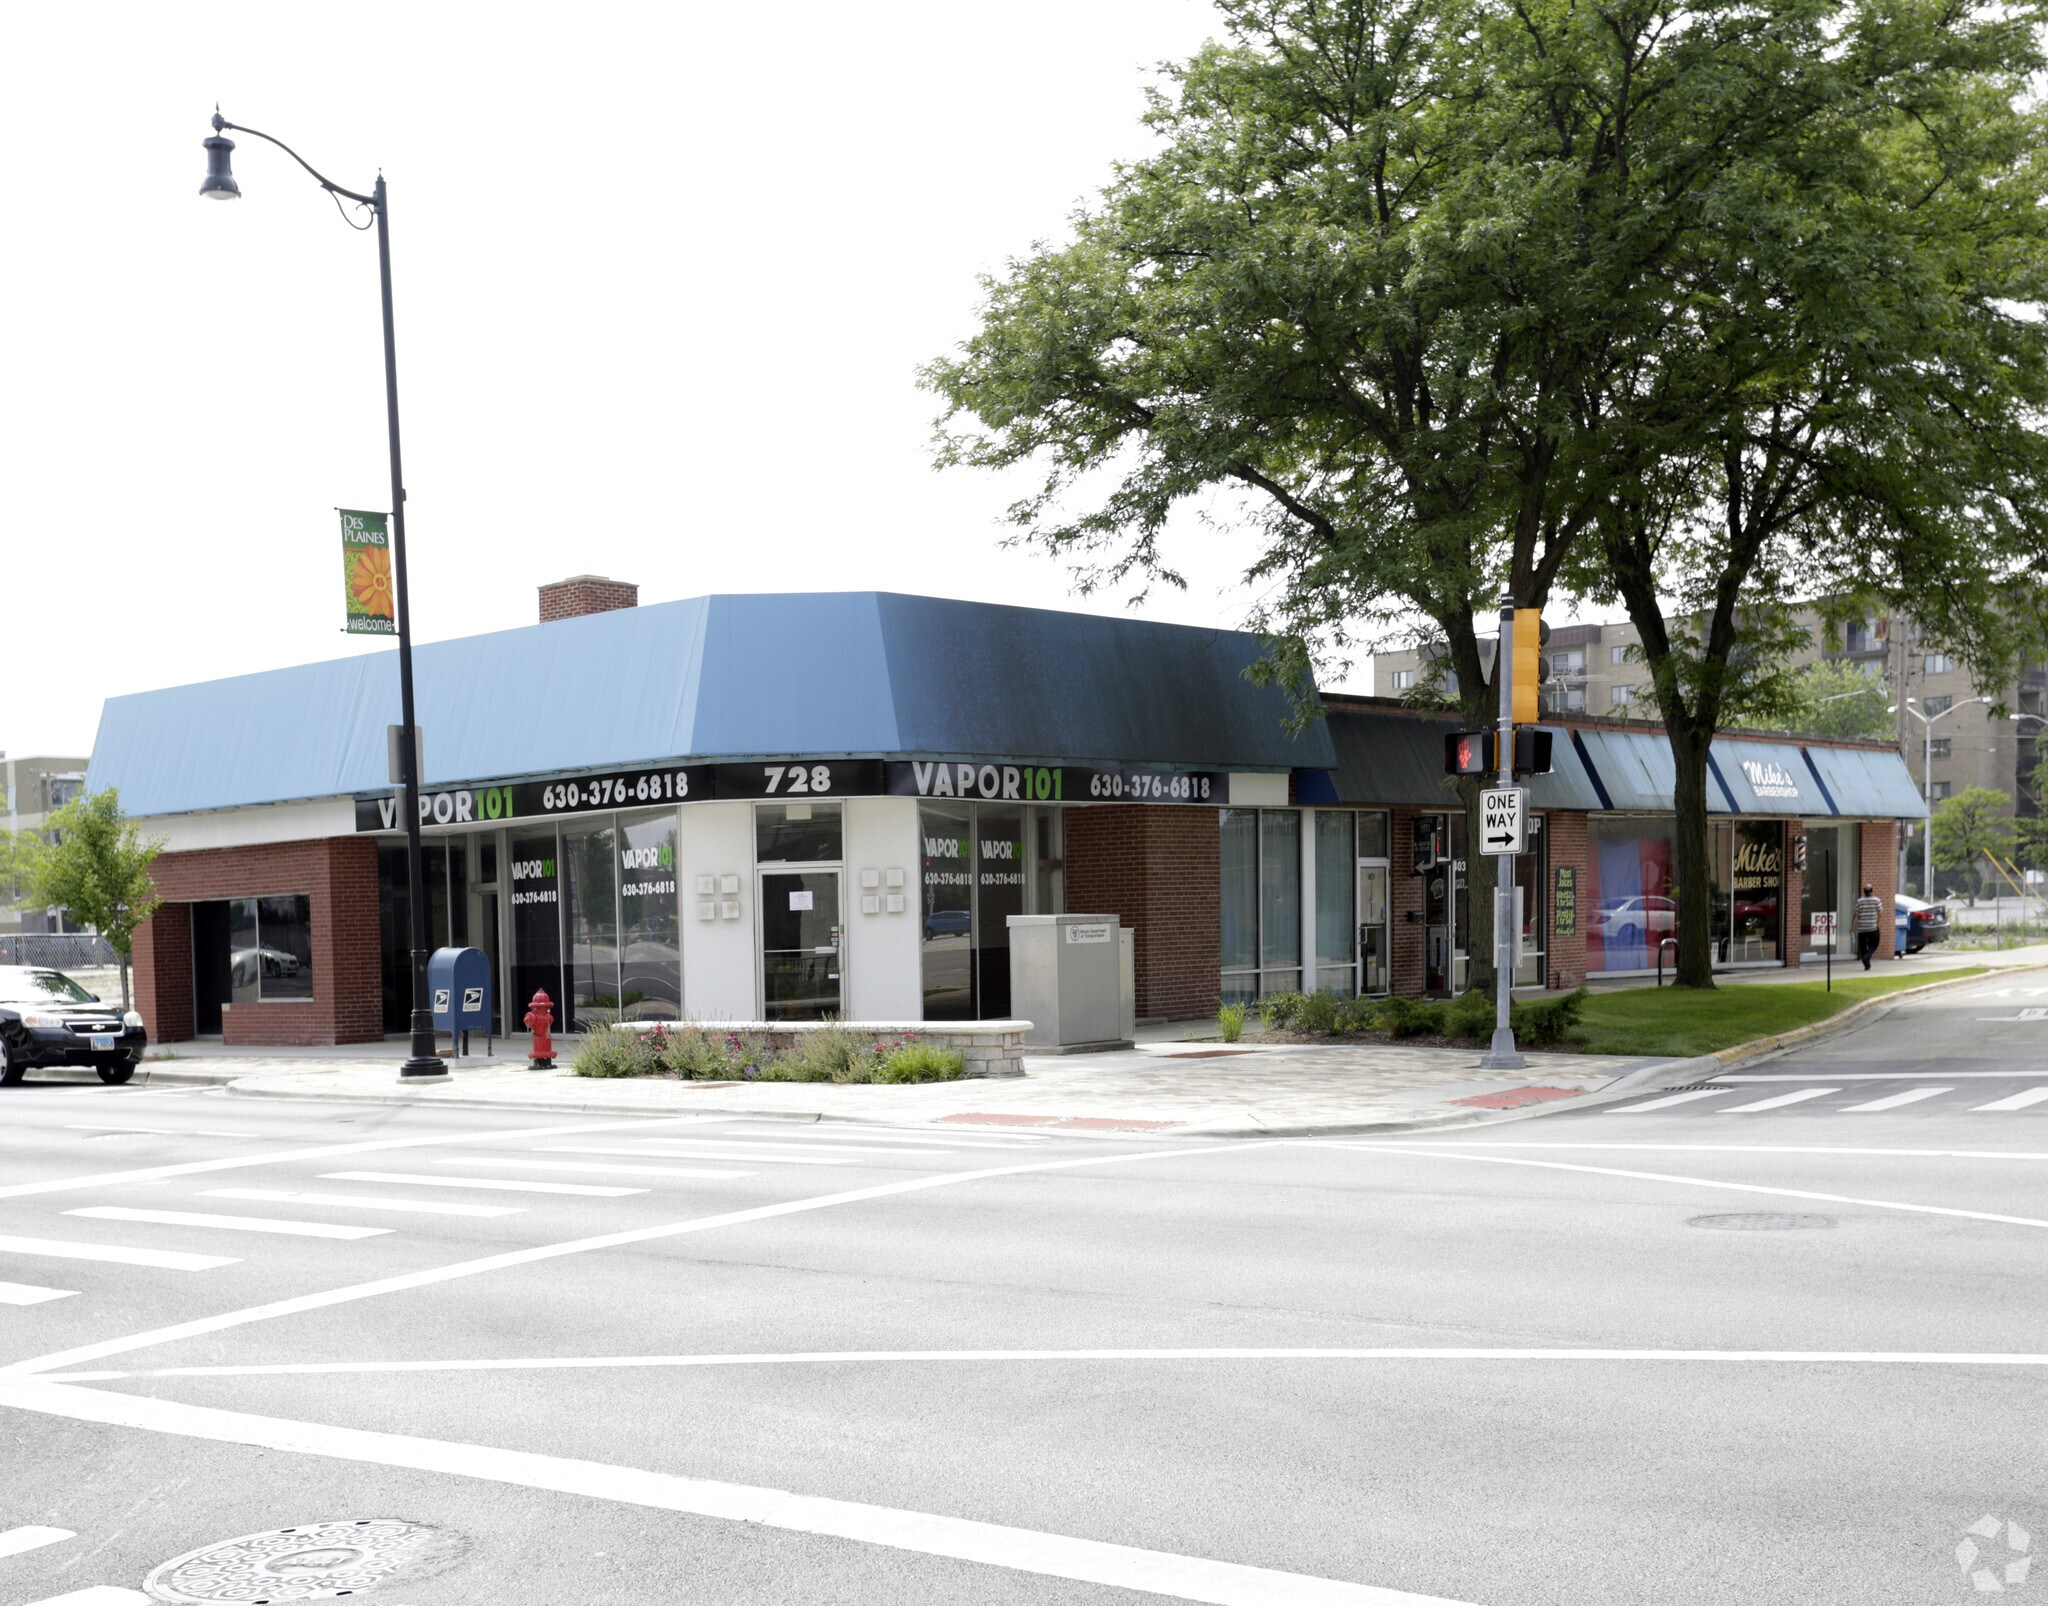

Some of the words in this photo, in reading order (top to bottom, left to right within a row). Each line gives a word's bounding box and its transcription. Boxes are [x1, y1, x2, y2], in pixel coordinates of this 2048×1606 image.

[343, 514, 363, 530] DES
[344, 528, 385, 545] PLAINES
[350, 616, 392, 632] welcome
[764, 765, 831, 793] 728
[1743, 760, 1793, 786] Mike's
[1090, 774, 1210, 798] 630-376-6818
[378, 786, 513, 829] VPOR101
[543, 772, 688, 809] 630-376-6818
[1487, 794, 1516, 810] ONE
[1486, 812, 1516, 828] WAY
[1734, 843, 1781, 872] Mike's
[925, 872, 973, 885] 630-376-6818
[980, 873, 1026, 885] 630-376-6818
[1734, 877, 1761, 889] BARBER
[622, 881, 675, 896] 630-376-6818
[511, 890, 557, 905] 630-376-6818
[1815, 915, 1834, 924] FOR
